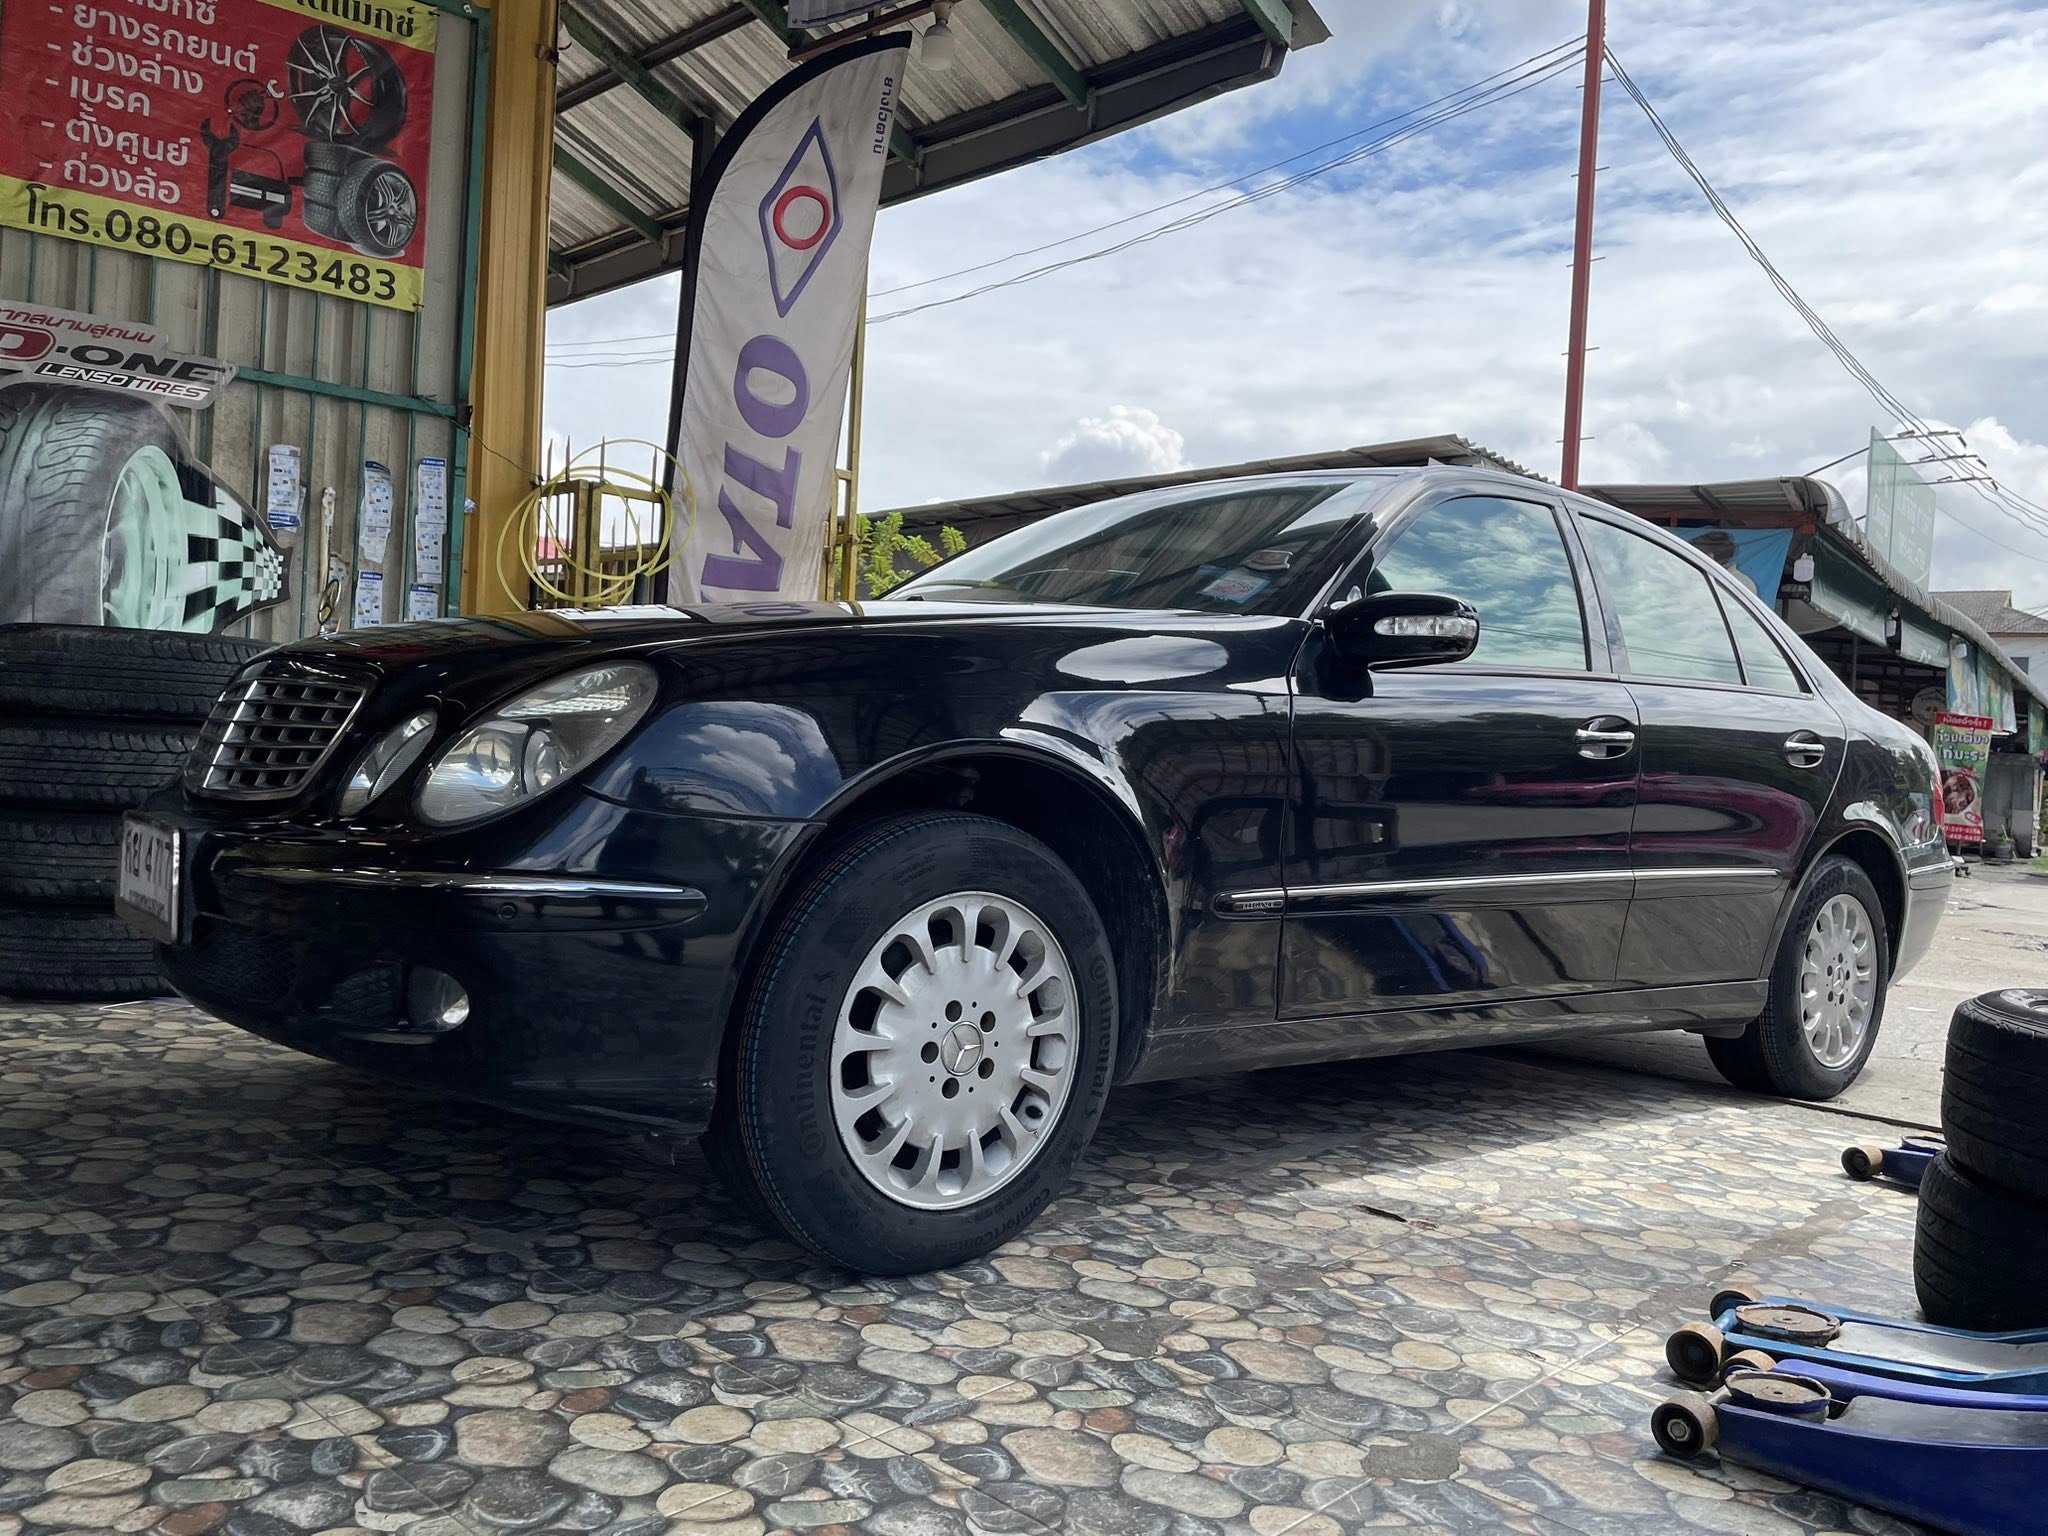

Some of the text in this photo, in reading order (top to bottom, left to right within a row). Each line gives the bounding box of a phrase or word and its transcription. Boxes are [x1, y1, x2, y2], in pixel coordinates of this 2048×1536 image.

[71, 35, 205, 95] ช่วงล่าง
[72, 3, 260, 74] ยางรถยนต์
[69, 76, 151, 117] เบรค
[64, 102, 192, 167] ตั้งศูนย์
[63, 151, 182, 205] ถ่วงล้อ
[0, 308, 156, 344] ากสนามสู่ถนน
[40, 363, 209, 399] LENSO TIRES
[701, 334, 811, 603] OTA
